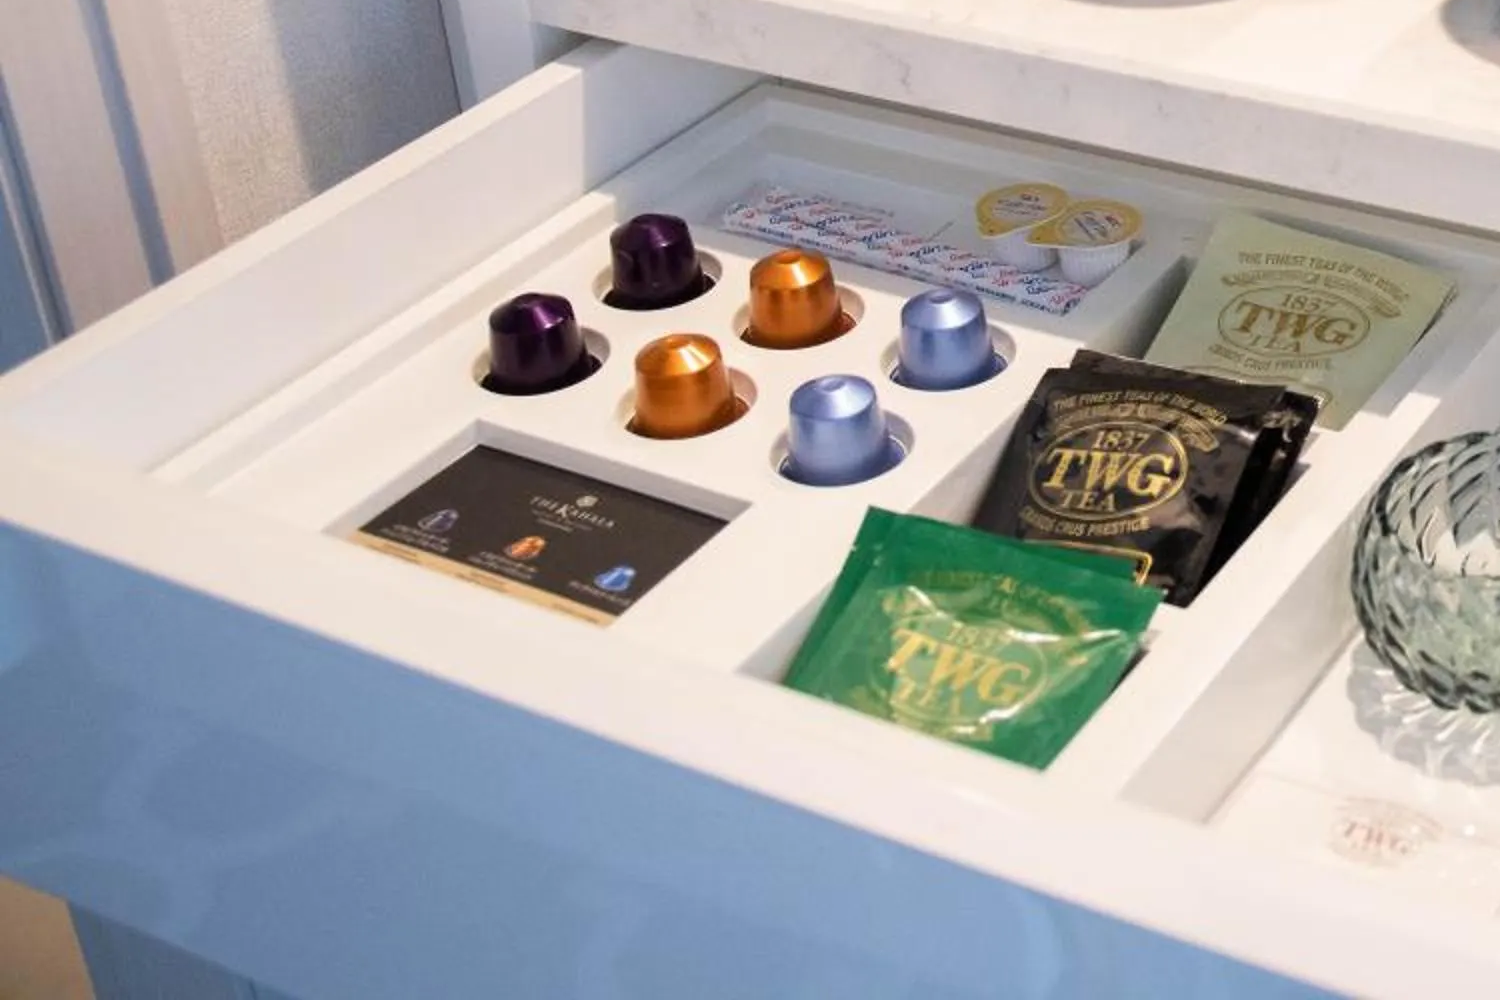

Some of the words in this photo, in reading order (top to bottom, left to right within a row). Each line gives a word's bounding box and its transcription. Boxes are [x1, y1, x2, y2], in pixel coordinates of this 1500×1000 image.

[1280, 293, 1339, 313] 1837
[1230, 300, 1358, 346] TWG
[1248, 335, 1301, 354] TEA
[1091, 430, 1151, 451] 1837
[1042, 448, 1174, 498] TWG
[1060, 489, 1116, 512] TEA
[887, 628, 1031, 706] TWG
